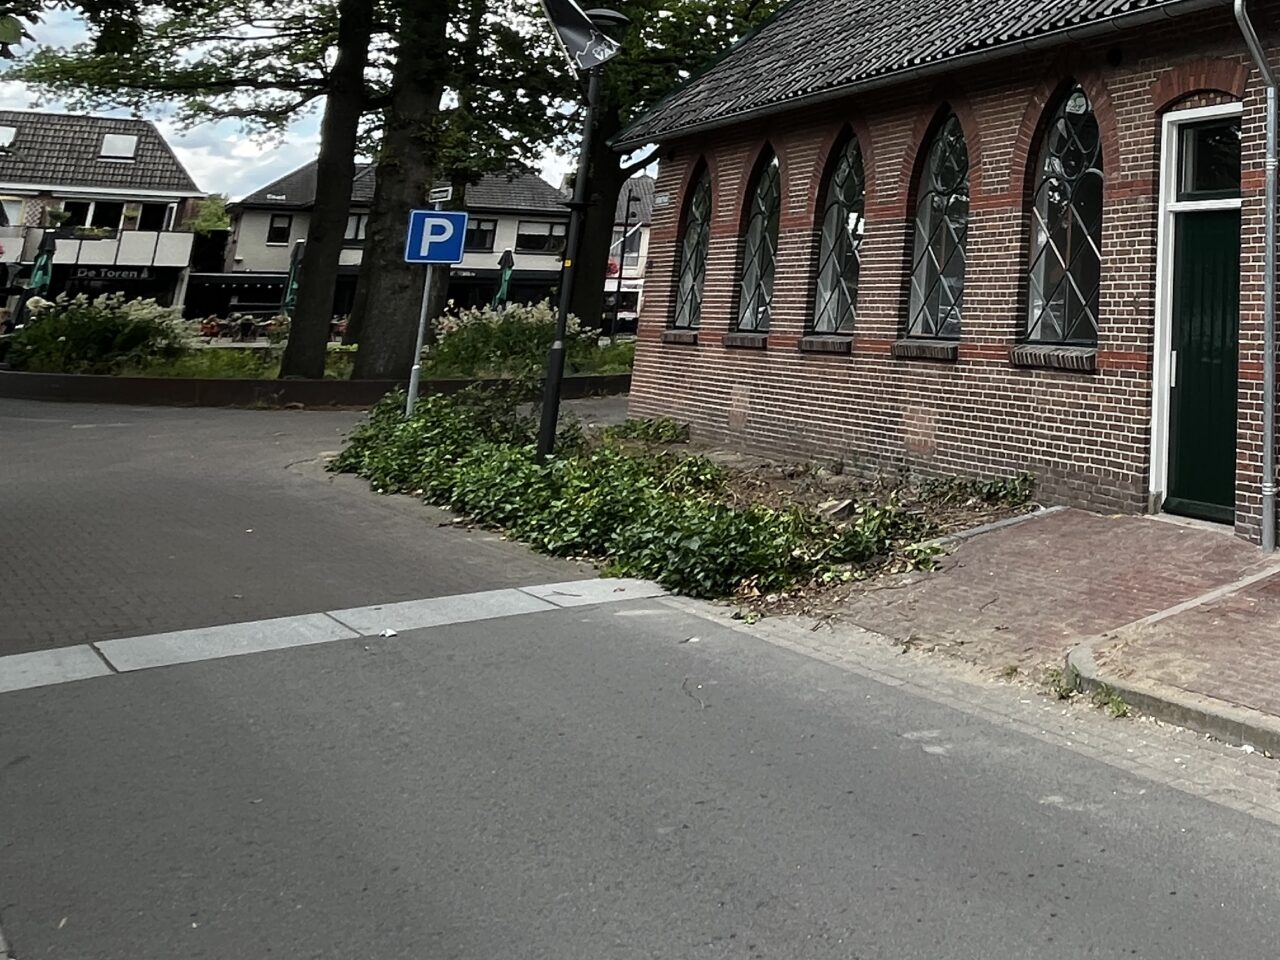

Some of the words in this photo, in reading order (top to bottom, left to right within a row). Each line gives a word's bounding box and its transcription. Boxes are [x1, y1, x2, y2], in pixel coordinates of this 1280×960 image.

[420, 218, 454, 257] P
[77, 268, 97, 277] De
[100, 269, 138, 278] Toren
